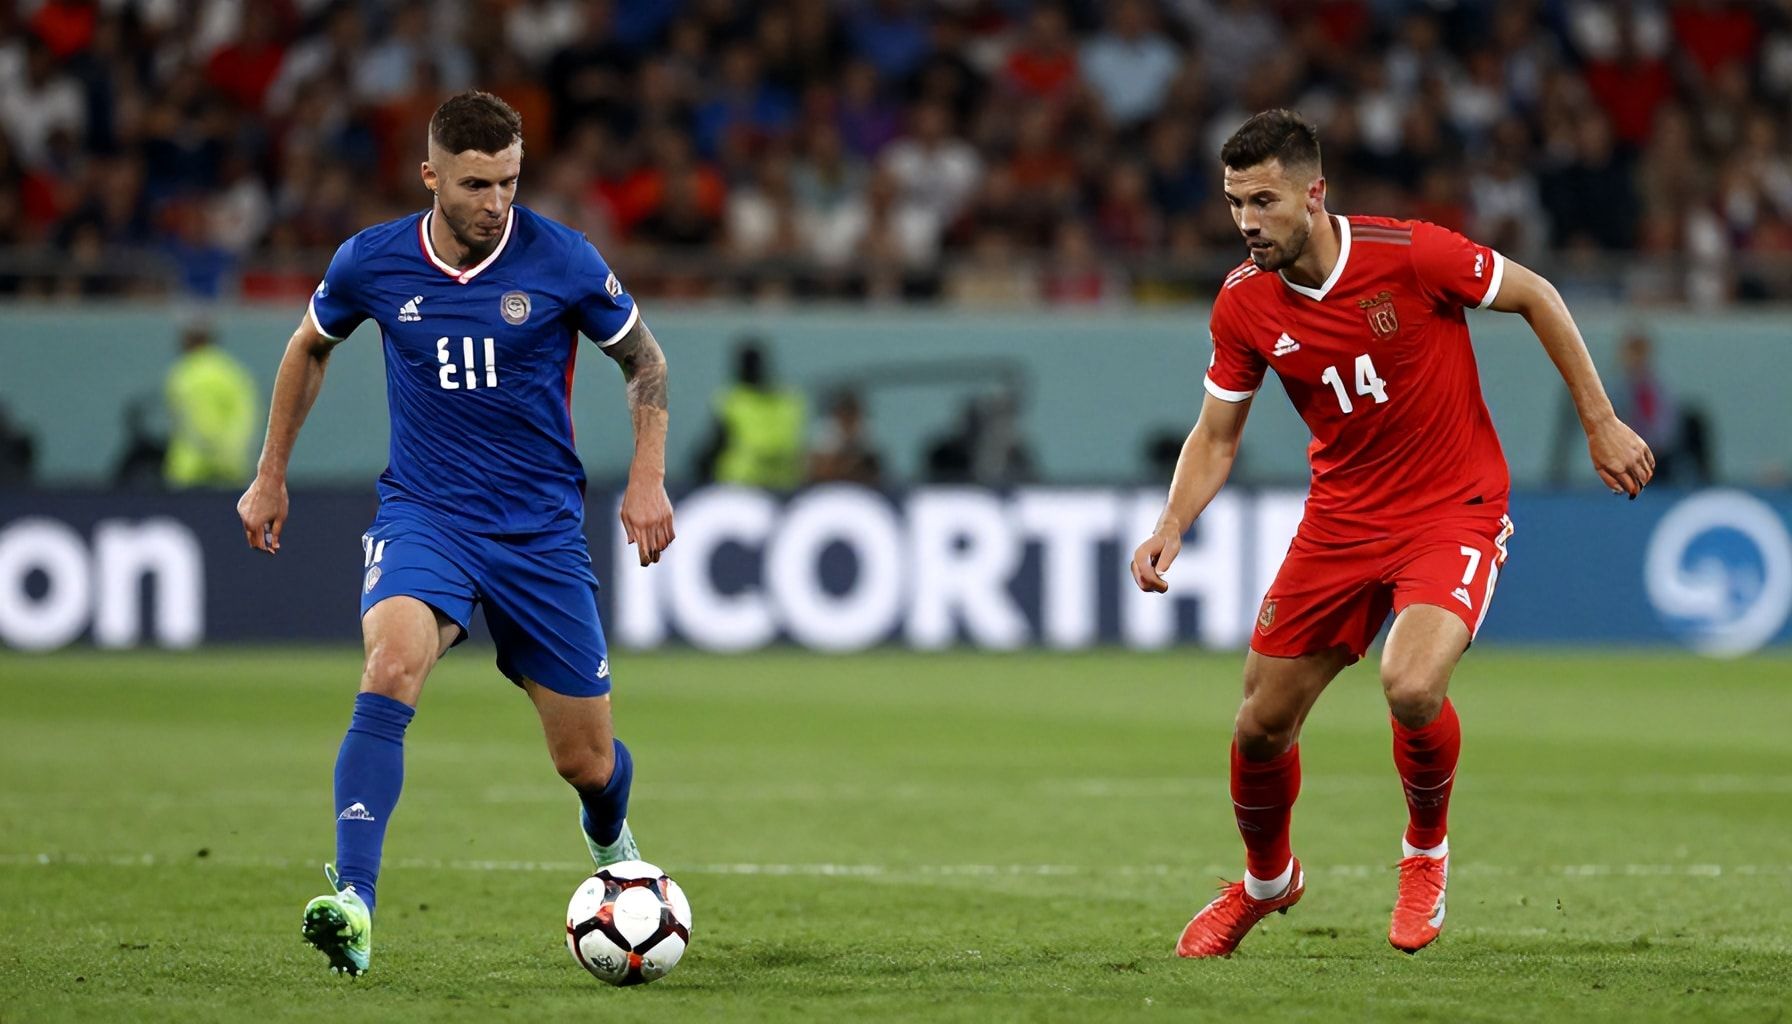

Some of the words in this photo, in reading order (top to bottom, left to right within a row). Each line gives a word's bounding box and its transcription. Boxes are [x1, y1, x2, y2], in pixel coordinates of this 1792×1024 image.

[1321, 353, 1389, 414] 14
[0, 515, 204, 650] on
[1460, 545, 1482, 585] 7
